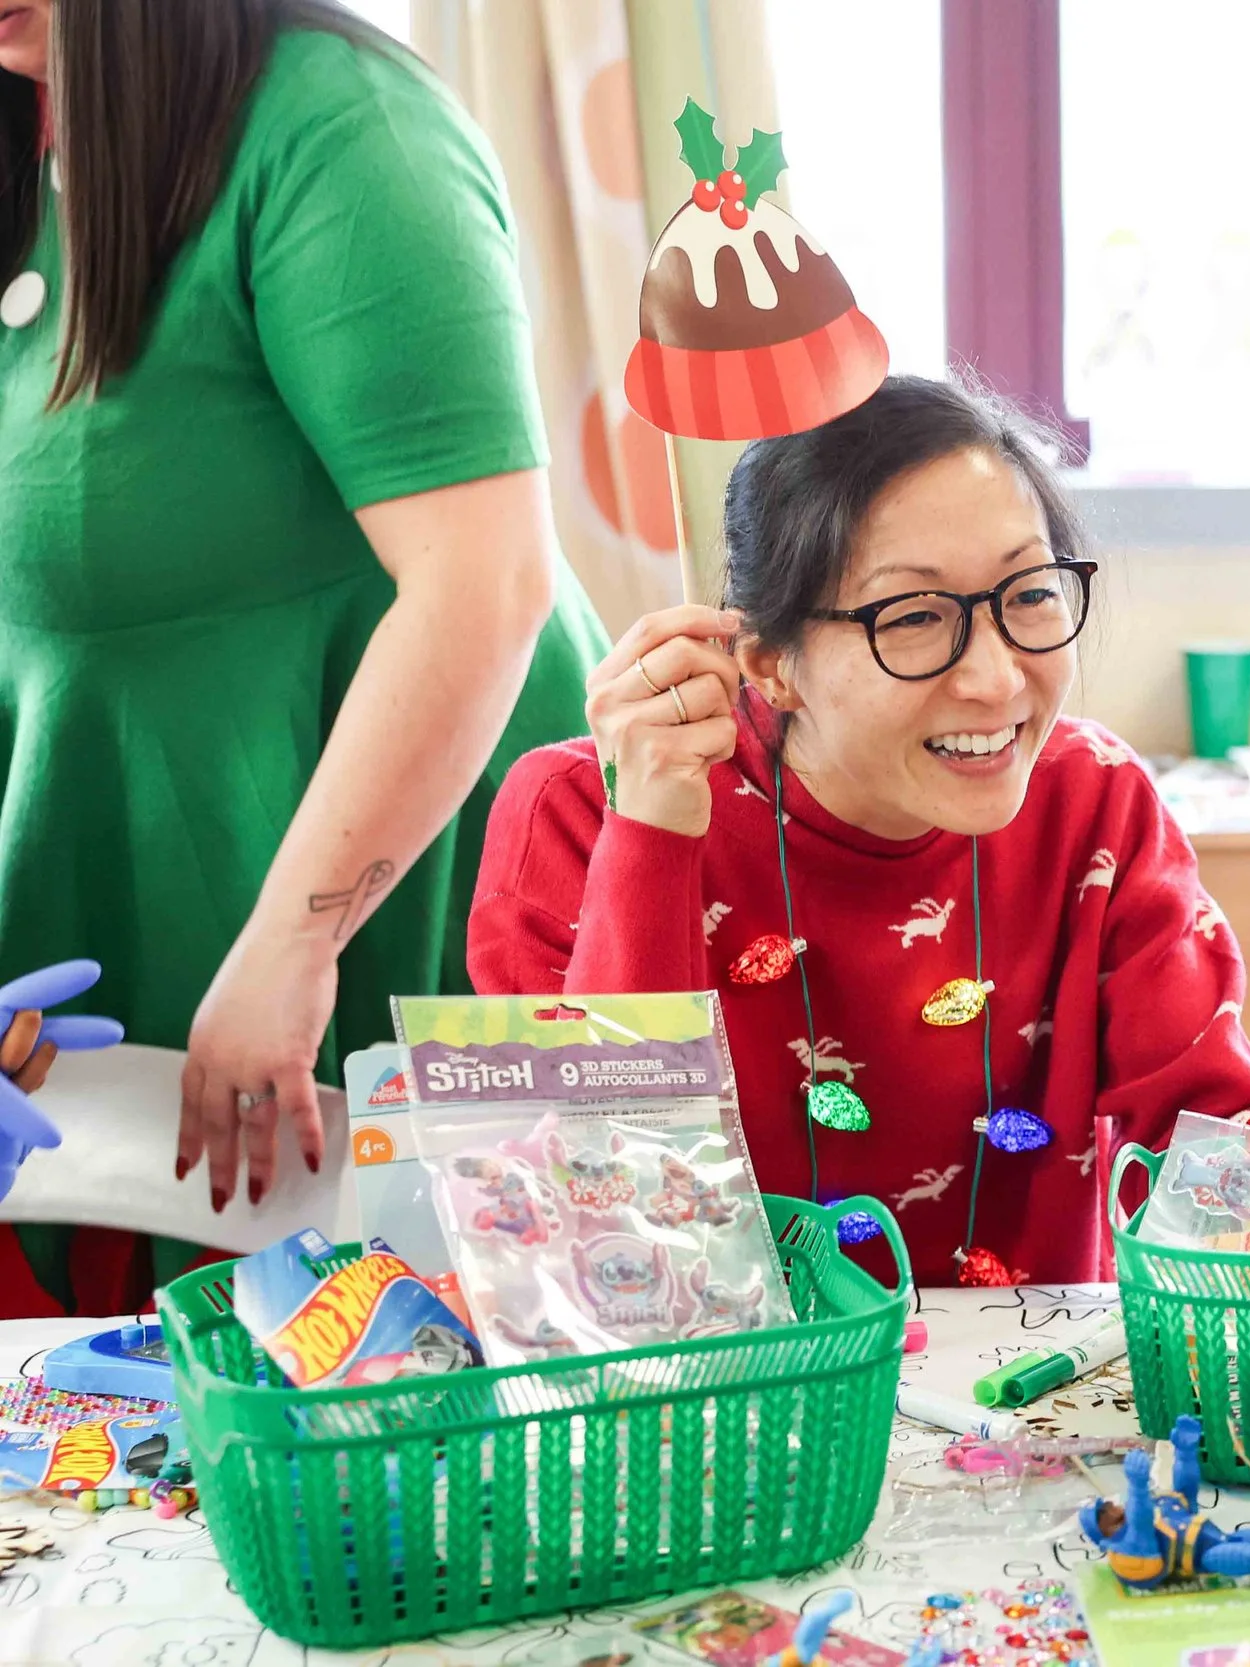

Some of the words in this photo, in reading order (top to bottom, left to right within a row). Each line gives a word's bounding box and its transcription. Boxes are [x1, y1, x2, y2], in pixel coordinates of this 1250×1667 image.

[560, 1063, 580, 1087] 9
[582, 1061, 599, 1073] 3D
[600, 1060, 665, 1072] STICKERS
[584, 1073, 688, 1087] AUTOCOLLANTS
[689, 1073, 707, 1085] 3D
[360, 1138, 372, 1159] 4
[275, 1308, 350, 1382] HOT
